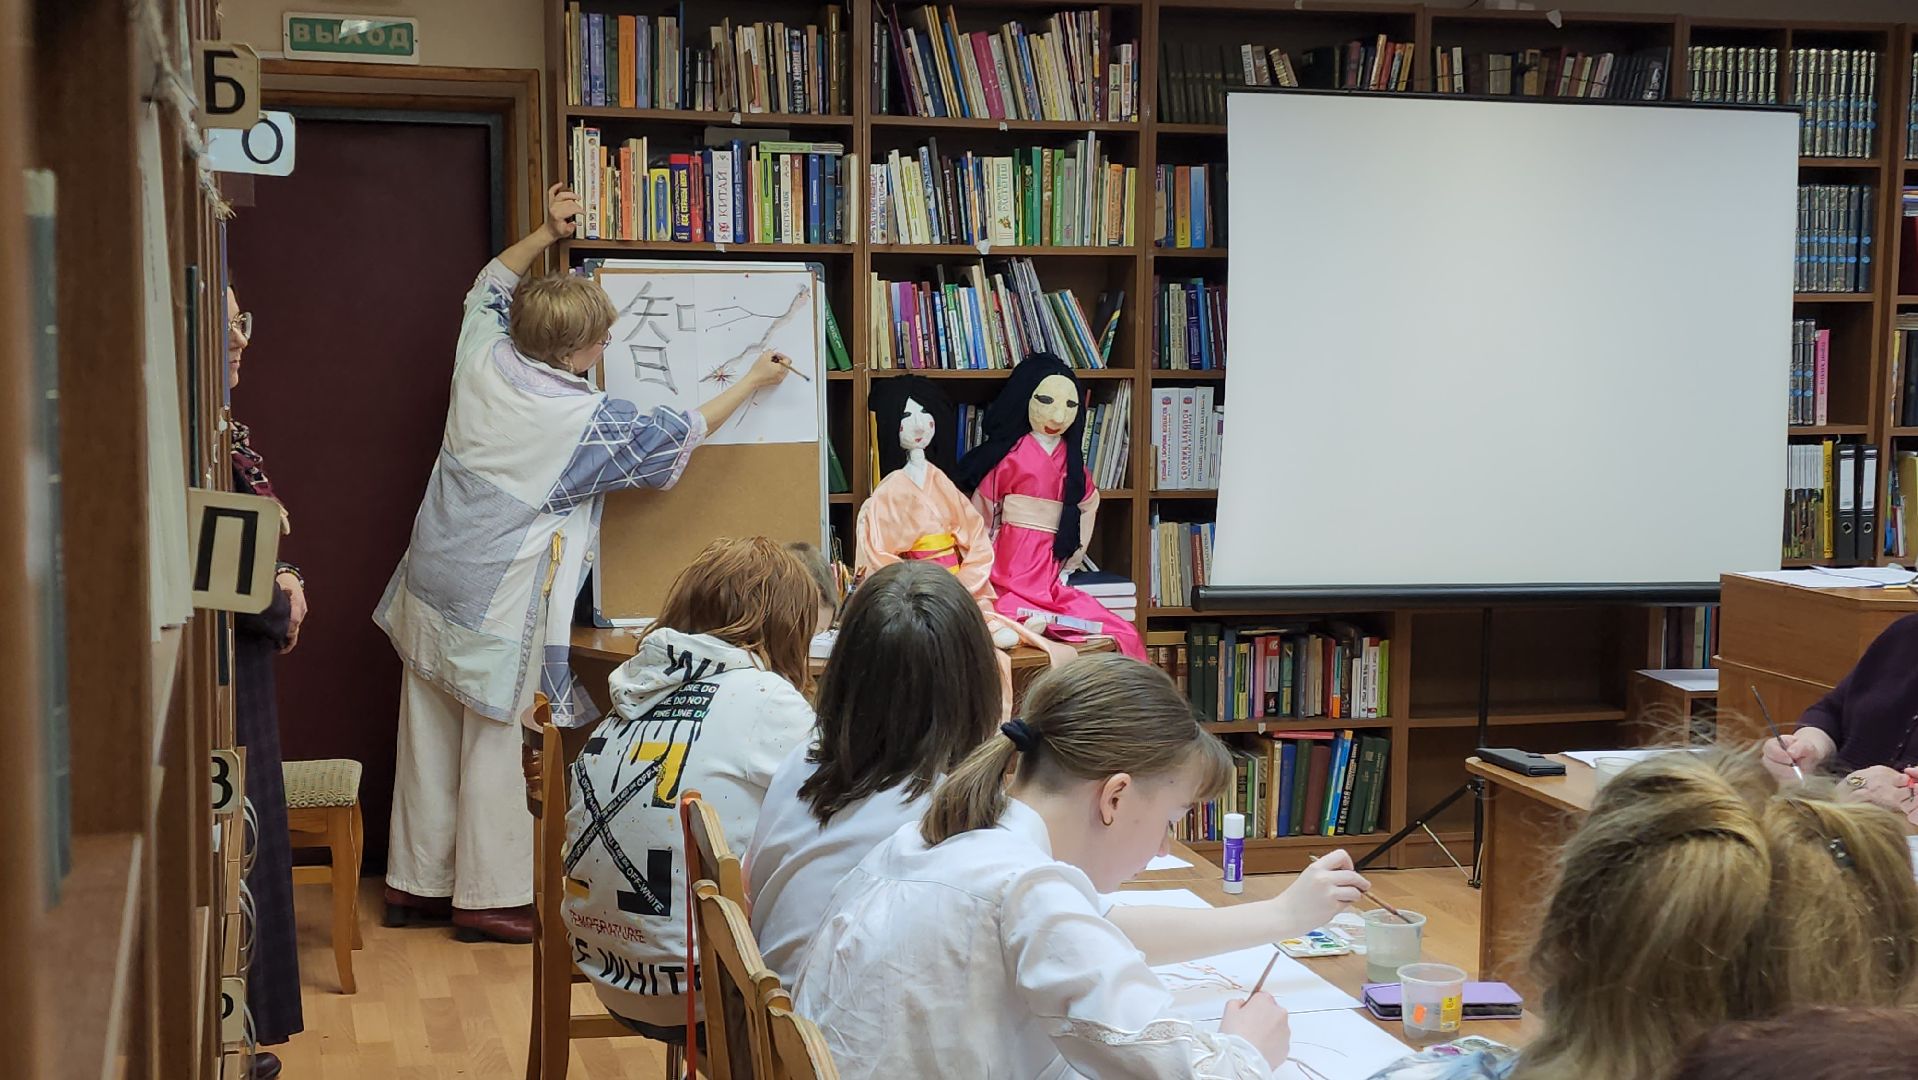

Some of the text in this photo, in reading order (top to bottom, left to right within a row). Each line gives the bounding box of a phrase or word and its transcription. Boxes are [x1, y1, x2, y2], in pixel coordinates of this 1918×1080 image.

[293, 22, 410, 49] ВЫХОД
[204, 50, 246, 114] Б
[716, 171, 728, 217] КИТАЙ
[193, 505, 259, 595] П
[626, 867, 665, 914] OFF-WHITE
